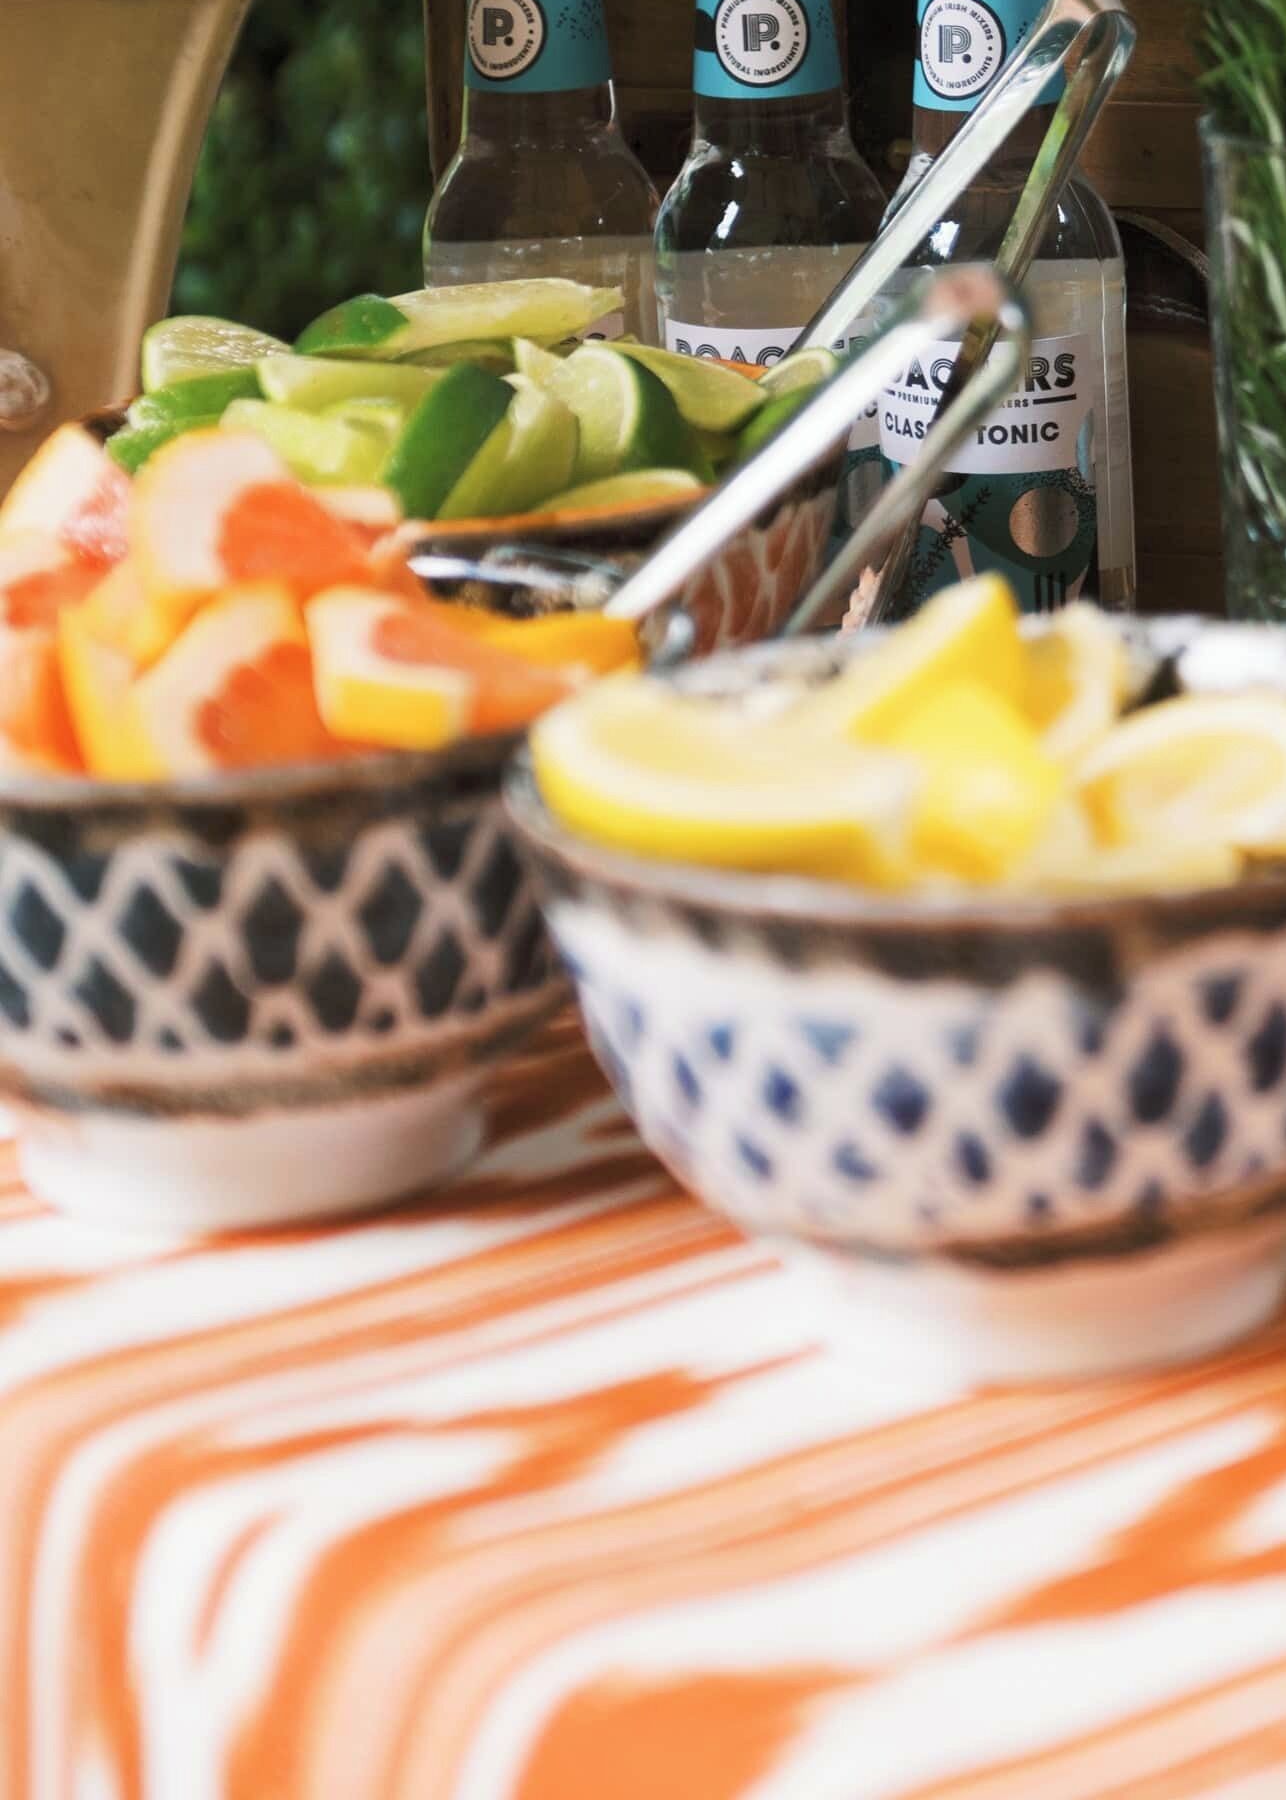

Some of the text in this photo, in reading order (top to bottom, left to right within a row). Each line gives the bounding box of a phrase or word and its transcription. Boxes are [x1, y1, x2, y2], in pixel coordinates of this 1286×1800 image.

[969, 9, 994, 41] MIXERS
[946, 54, 994, 89] INGREDIENTS
[976, 421, 1060, 446] TONIC
